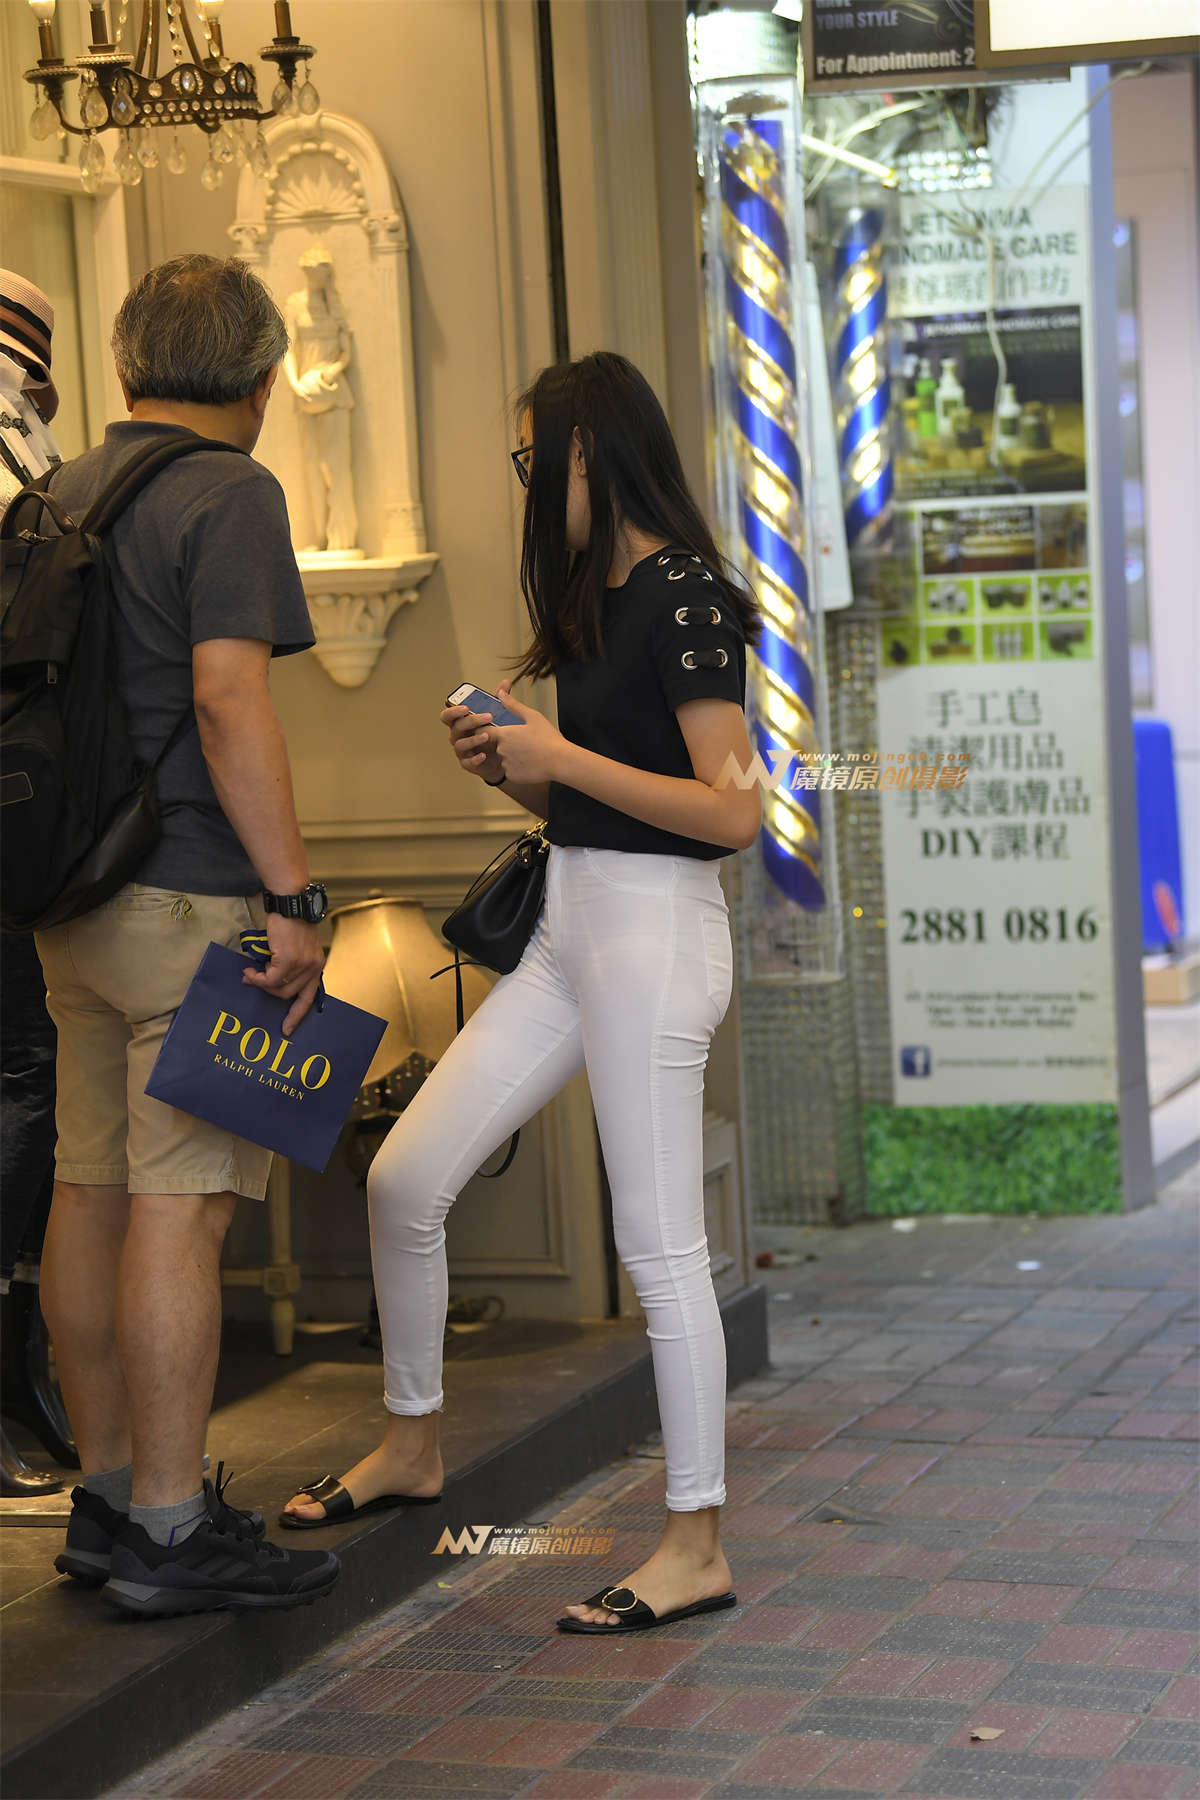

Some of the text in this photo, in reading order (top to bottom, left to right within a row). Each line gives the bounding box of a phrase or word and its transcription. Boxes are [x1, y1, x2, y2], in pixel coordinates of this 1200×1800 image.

[816, 9, 898, 30] YOUR STYLE
[816, 56, 844, 74] For
[846, 49, 961, 74] Appointment:
[1010, 232, 1078, 259] CARE
[926, 686, 1043, 728] 手工皂
[901, 907, 1098, 943] 2881 0816
[206, 1010, 331, 1090] POLO
[213, 1053, 305, 1101] RALPH LAUREN
